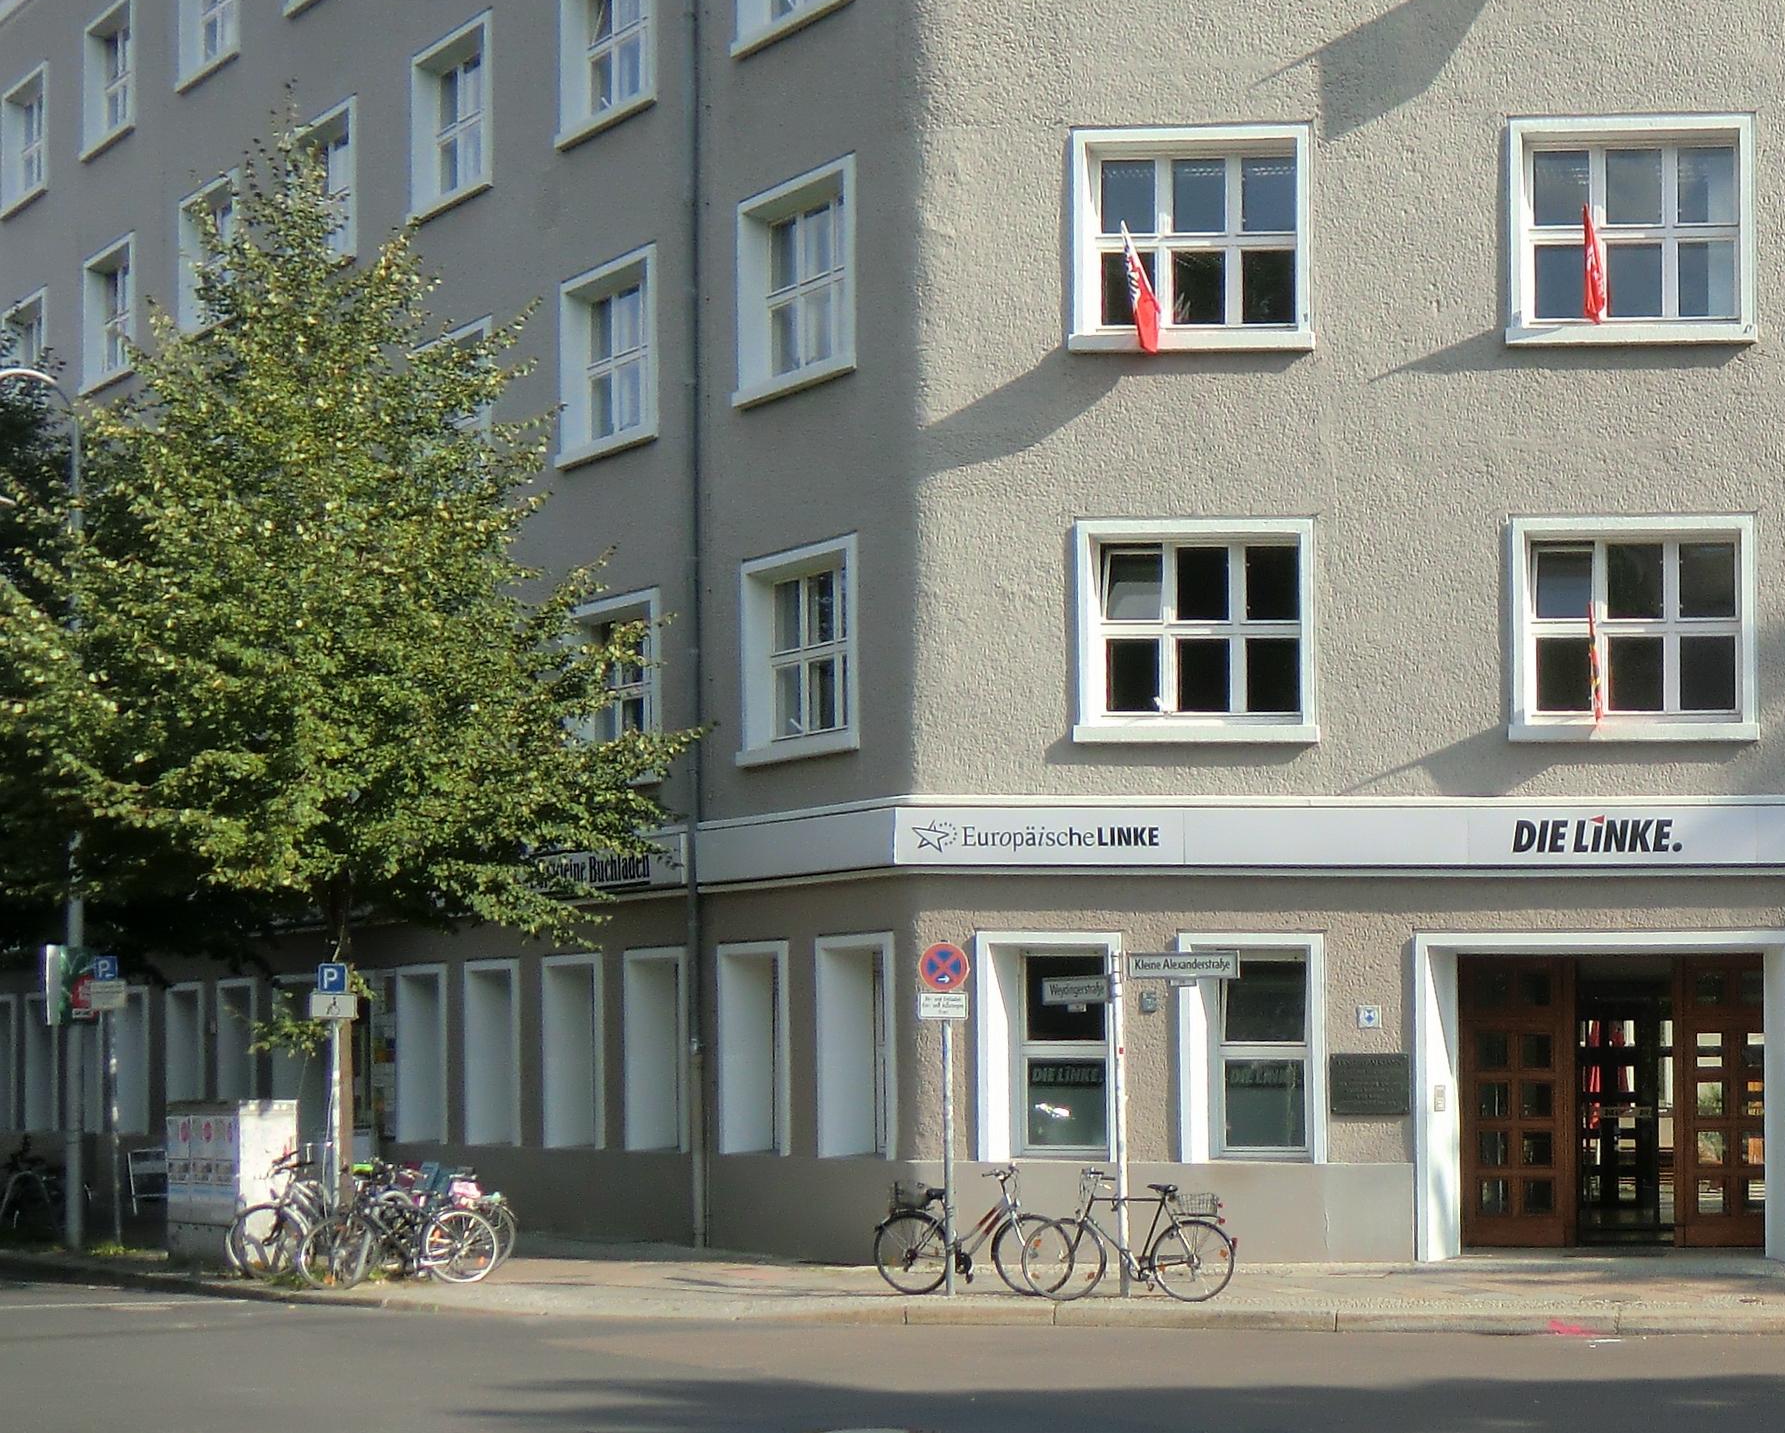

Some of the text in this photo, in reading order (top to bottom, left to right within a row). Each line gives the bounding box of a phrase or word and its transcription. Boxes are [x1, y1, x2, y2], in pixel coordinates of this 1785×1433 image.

[1512, 815, 1683, 853] DIE LINKE.
[589, 854, 650, 883] Buchladen
[1135, 958, 1231, 972] Kleine Alexanderstraße
[324, 968, 338, 989] P
[1050, 981, 1105, 998] Weydingerstraße
